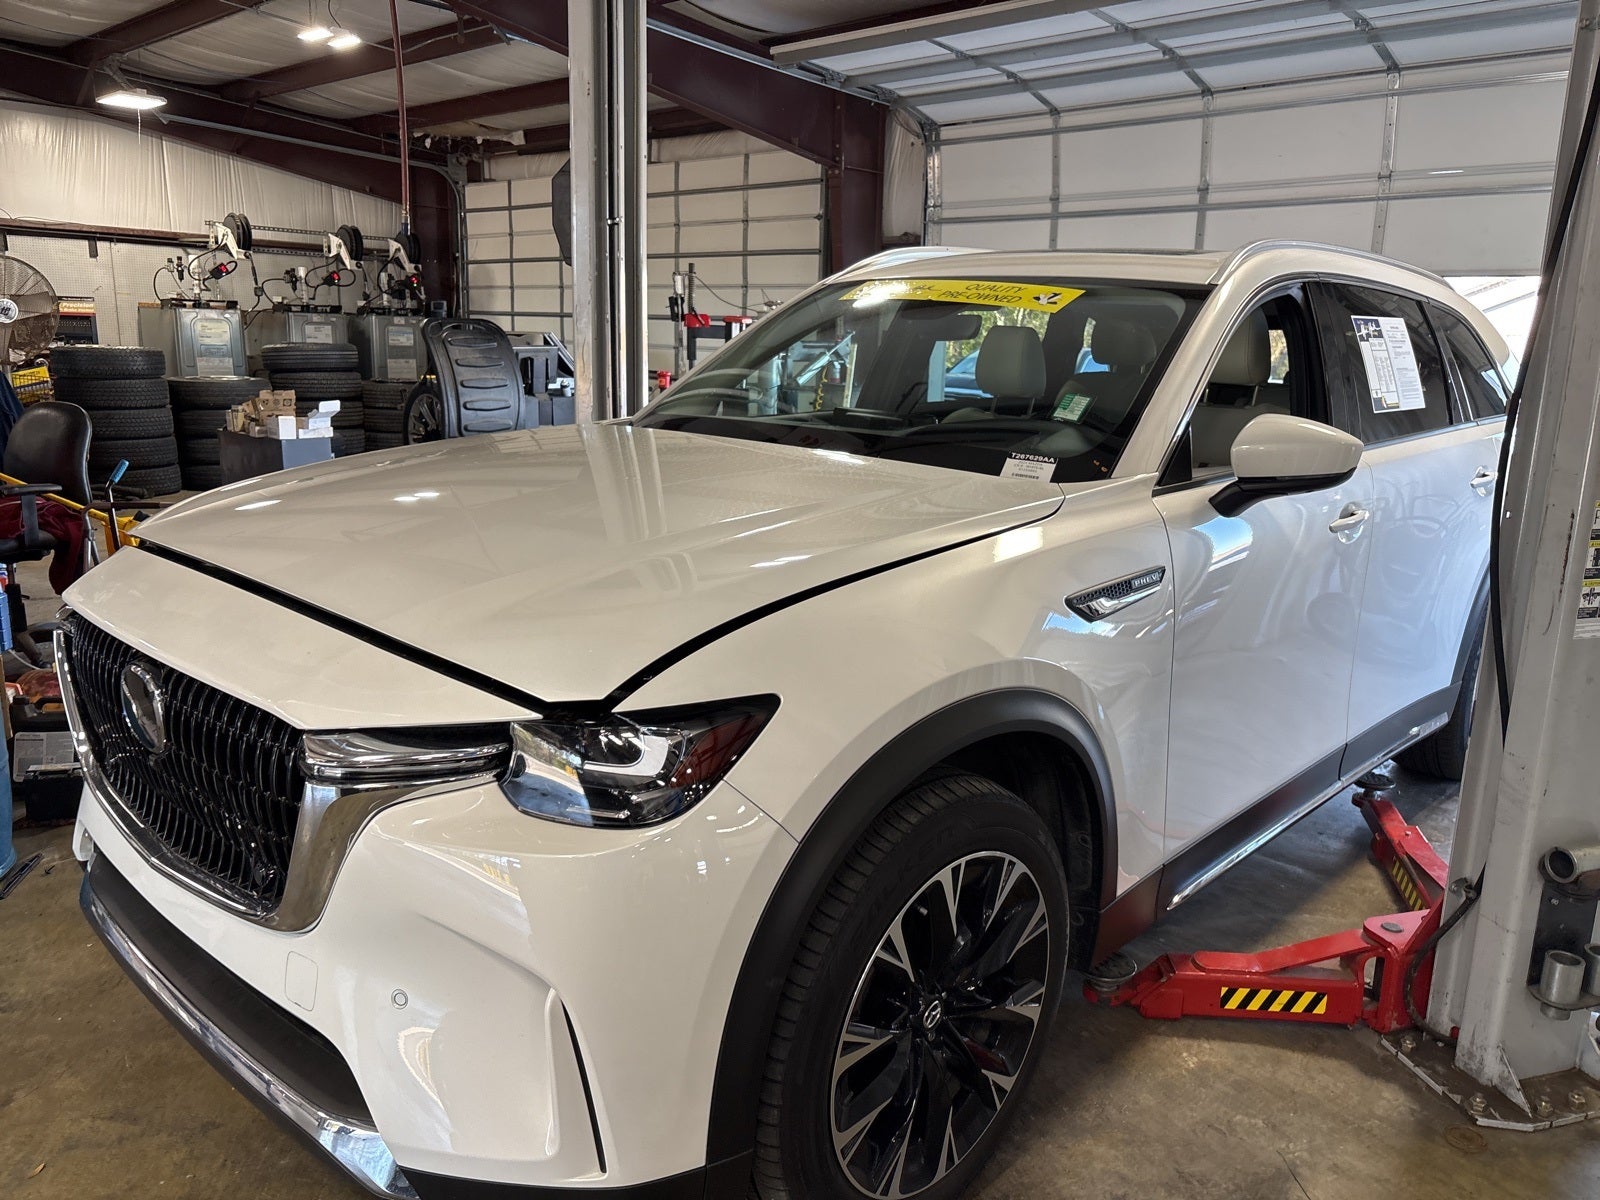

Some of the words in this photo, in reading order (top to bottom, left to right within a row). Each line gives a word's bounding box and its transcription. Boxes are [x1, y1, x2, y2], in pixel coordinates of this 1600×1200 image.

[966, 283, 1028, 293] QUALITY
[938, 290, 1022, 304] PRE-OWNED
[1011, 452, 1055, 463] T267629AA
